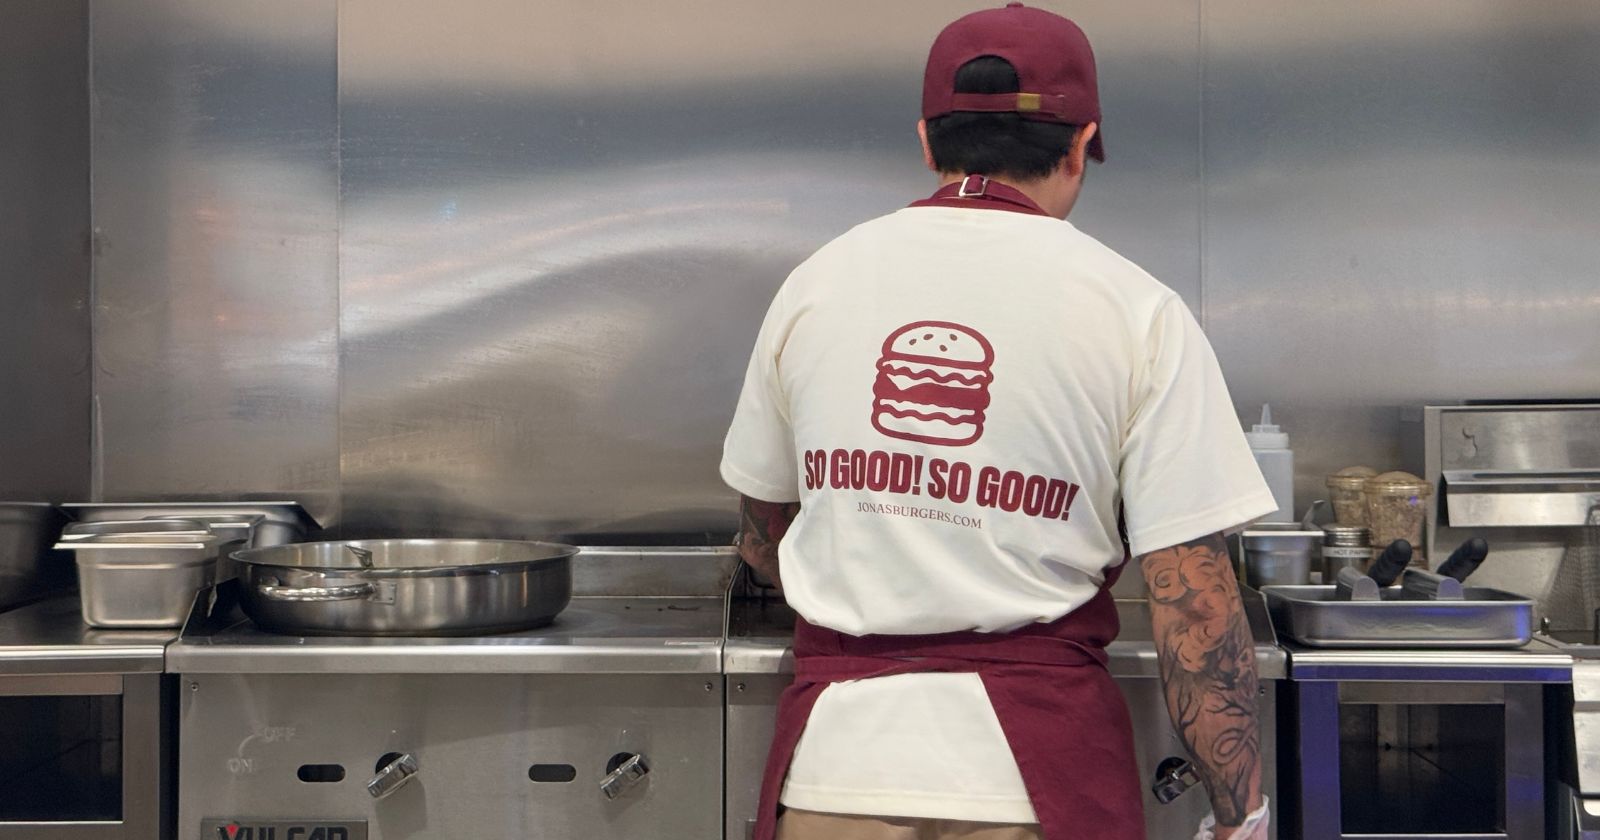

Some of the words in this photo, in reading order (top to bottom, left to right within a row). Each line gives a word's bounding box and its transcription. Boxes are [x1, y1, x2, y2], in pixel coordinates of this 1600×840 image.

[804, 449, 827, 490] SO
[830, 448, 924, 495] GOOD!
[927, 458, 972, 504] SO
[976, 466, 1080, 521] GOOD!
[857, 502, 982, 529] JONASBURGERS.COM
[227, 758, 253, 773] ON
